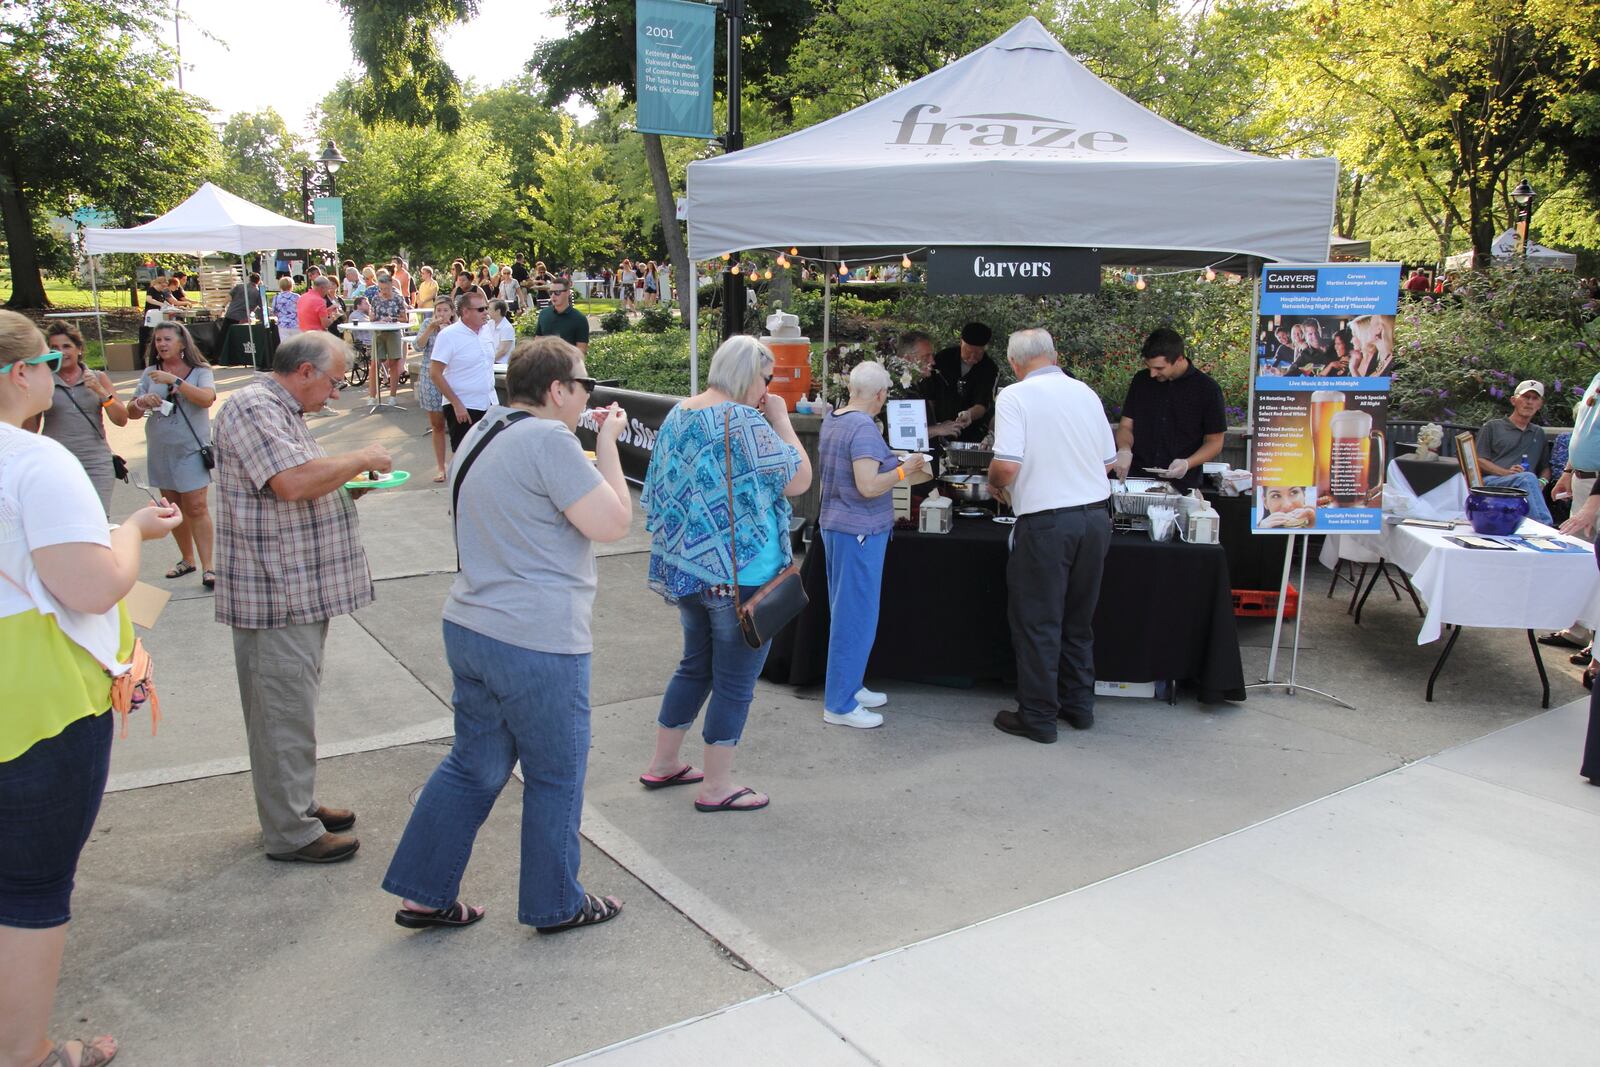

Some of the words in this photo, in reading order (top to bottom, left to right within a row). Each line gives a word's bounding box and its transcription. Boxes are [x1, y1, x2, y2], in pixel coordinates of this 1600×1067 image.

[646, 26, 674, 39] 2001
[645, 49, 670, 59] Kettering
[671, 53, 692, 61] Moraine
[645, 58, 670, 67] Oakwood
[672, 61, 695, 70] Chamber
[652, 68, 680, 77] Commerce
[673, 88, 699, 96] Commons
[884, 104, 1128, 152] fraze
[974, 256, 1051, 278] Carvers
